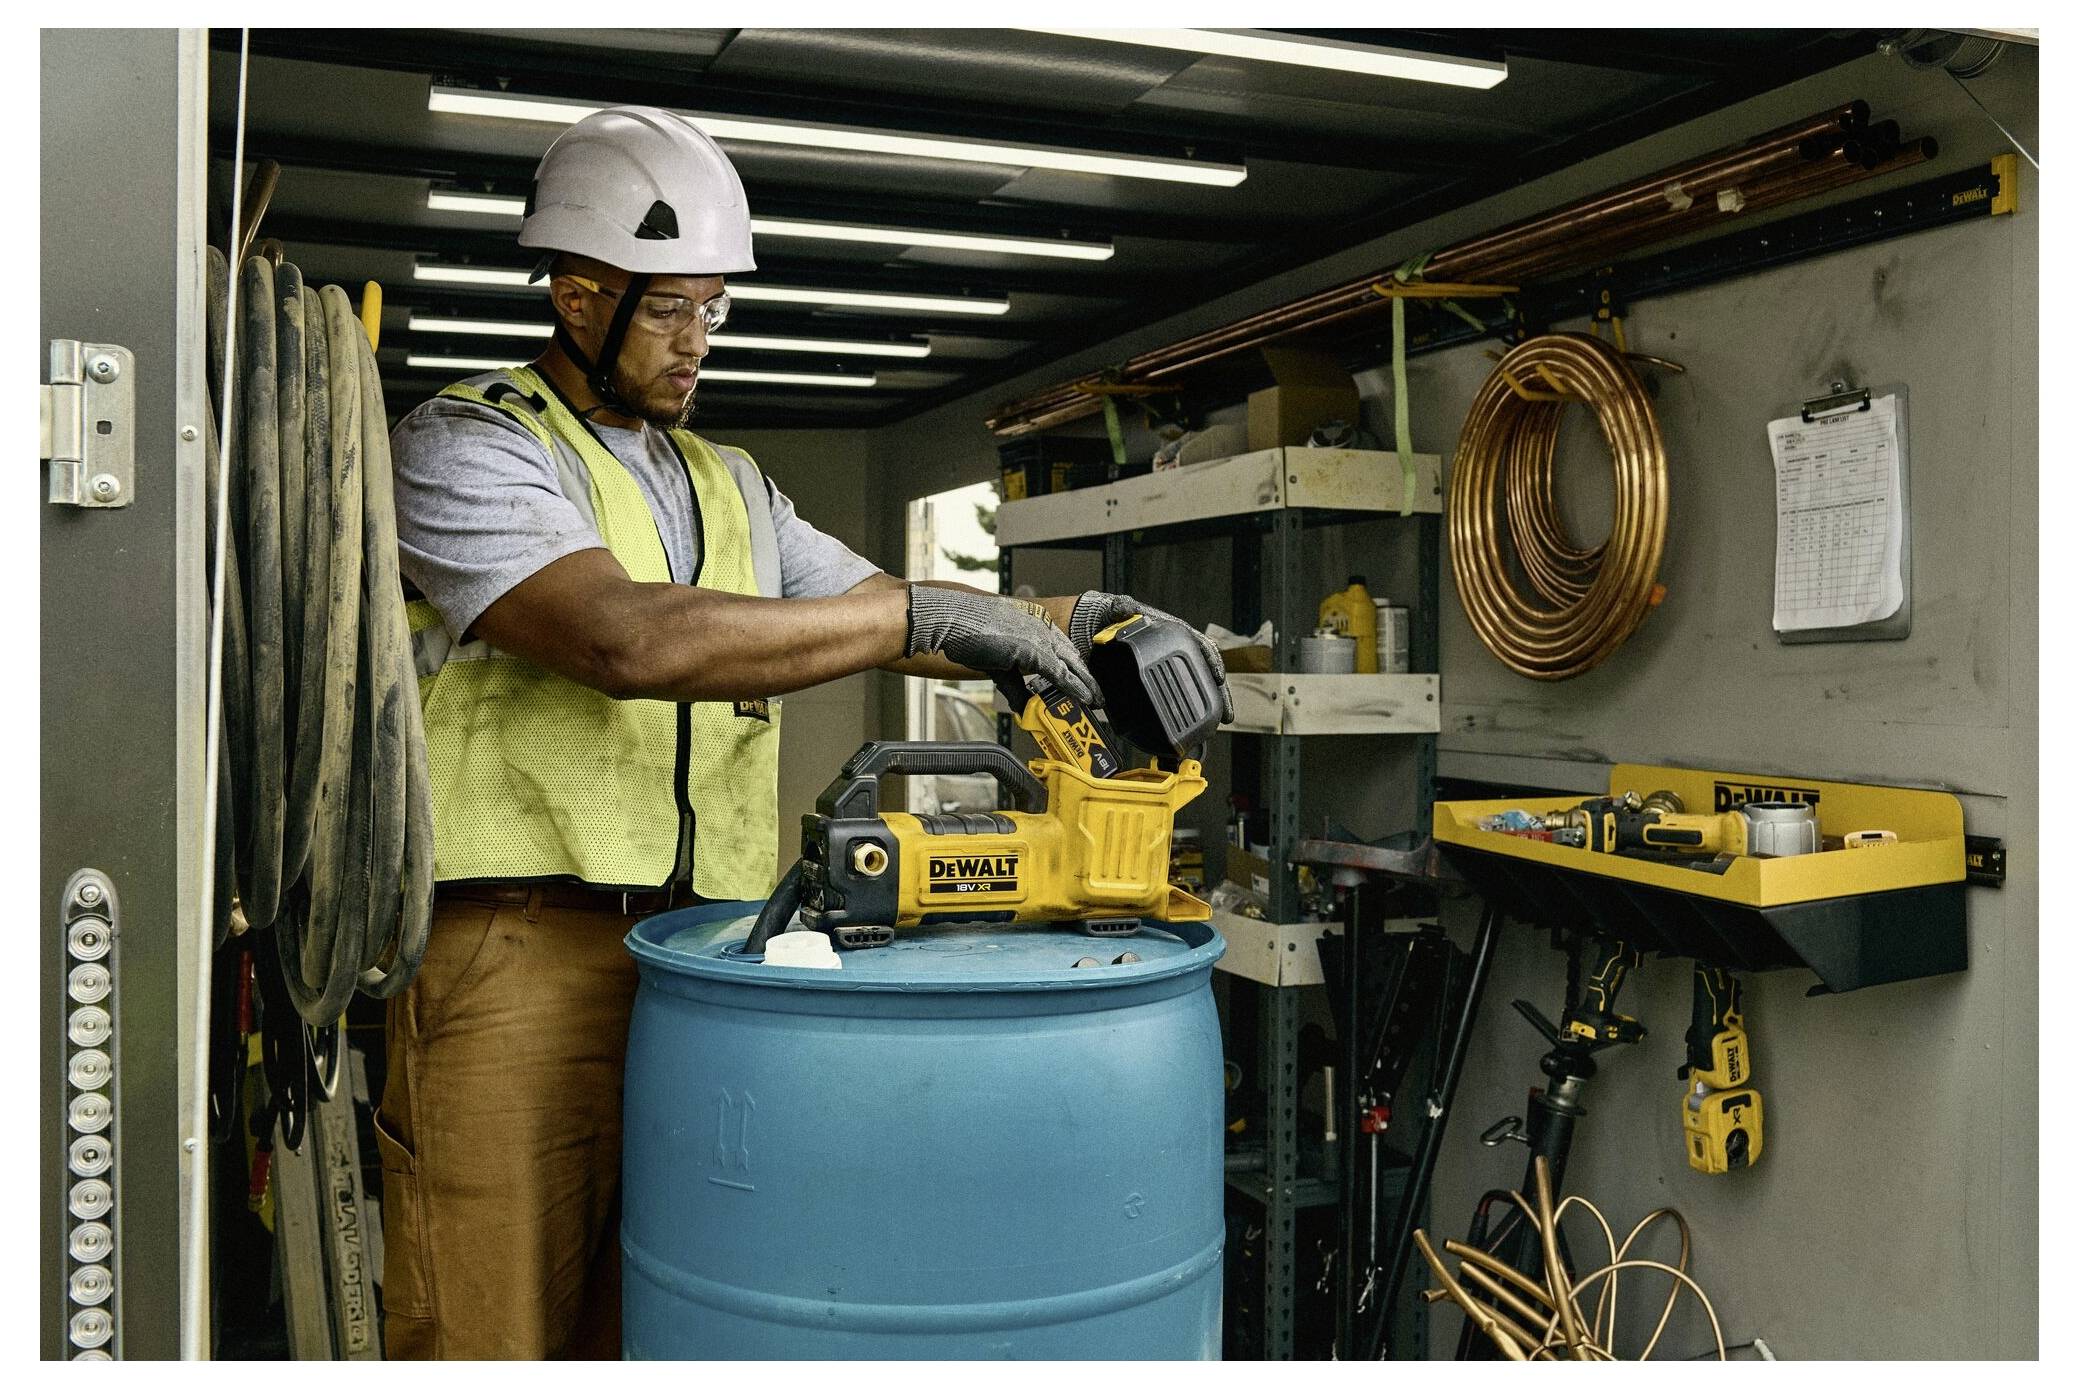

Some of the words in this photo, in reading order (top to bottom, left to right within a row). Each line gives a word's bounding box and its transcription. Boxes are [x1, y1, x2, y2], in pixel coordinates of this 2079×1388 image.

[1952, 187, 1988, 207] DEWALT
[1057, 702, 1071, 717] 5
[1062, 729, 1085, 758] DEWALT
[1071, 717, 1106, 753] XR
[1093, 752, 1110, 771] 18V
[929, 858, 1019, 878] DEWALT
[956, 884, 976, 892] 18V
[977, 883, 991, 891] XR
[1727, 1046, 1737, 1082] DEWALT
[1733, 1106, 1741, 1125] XR
